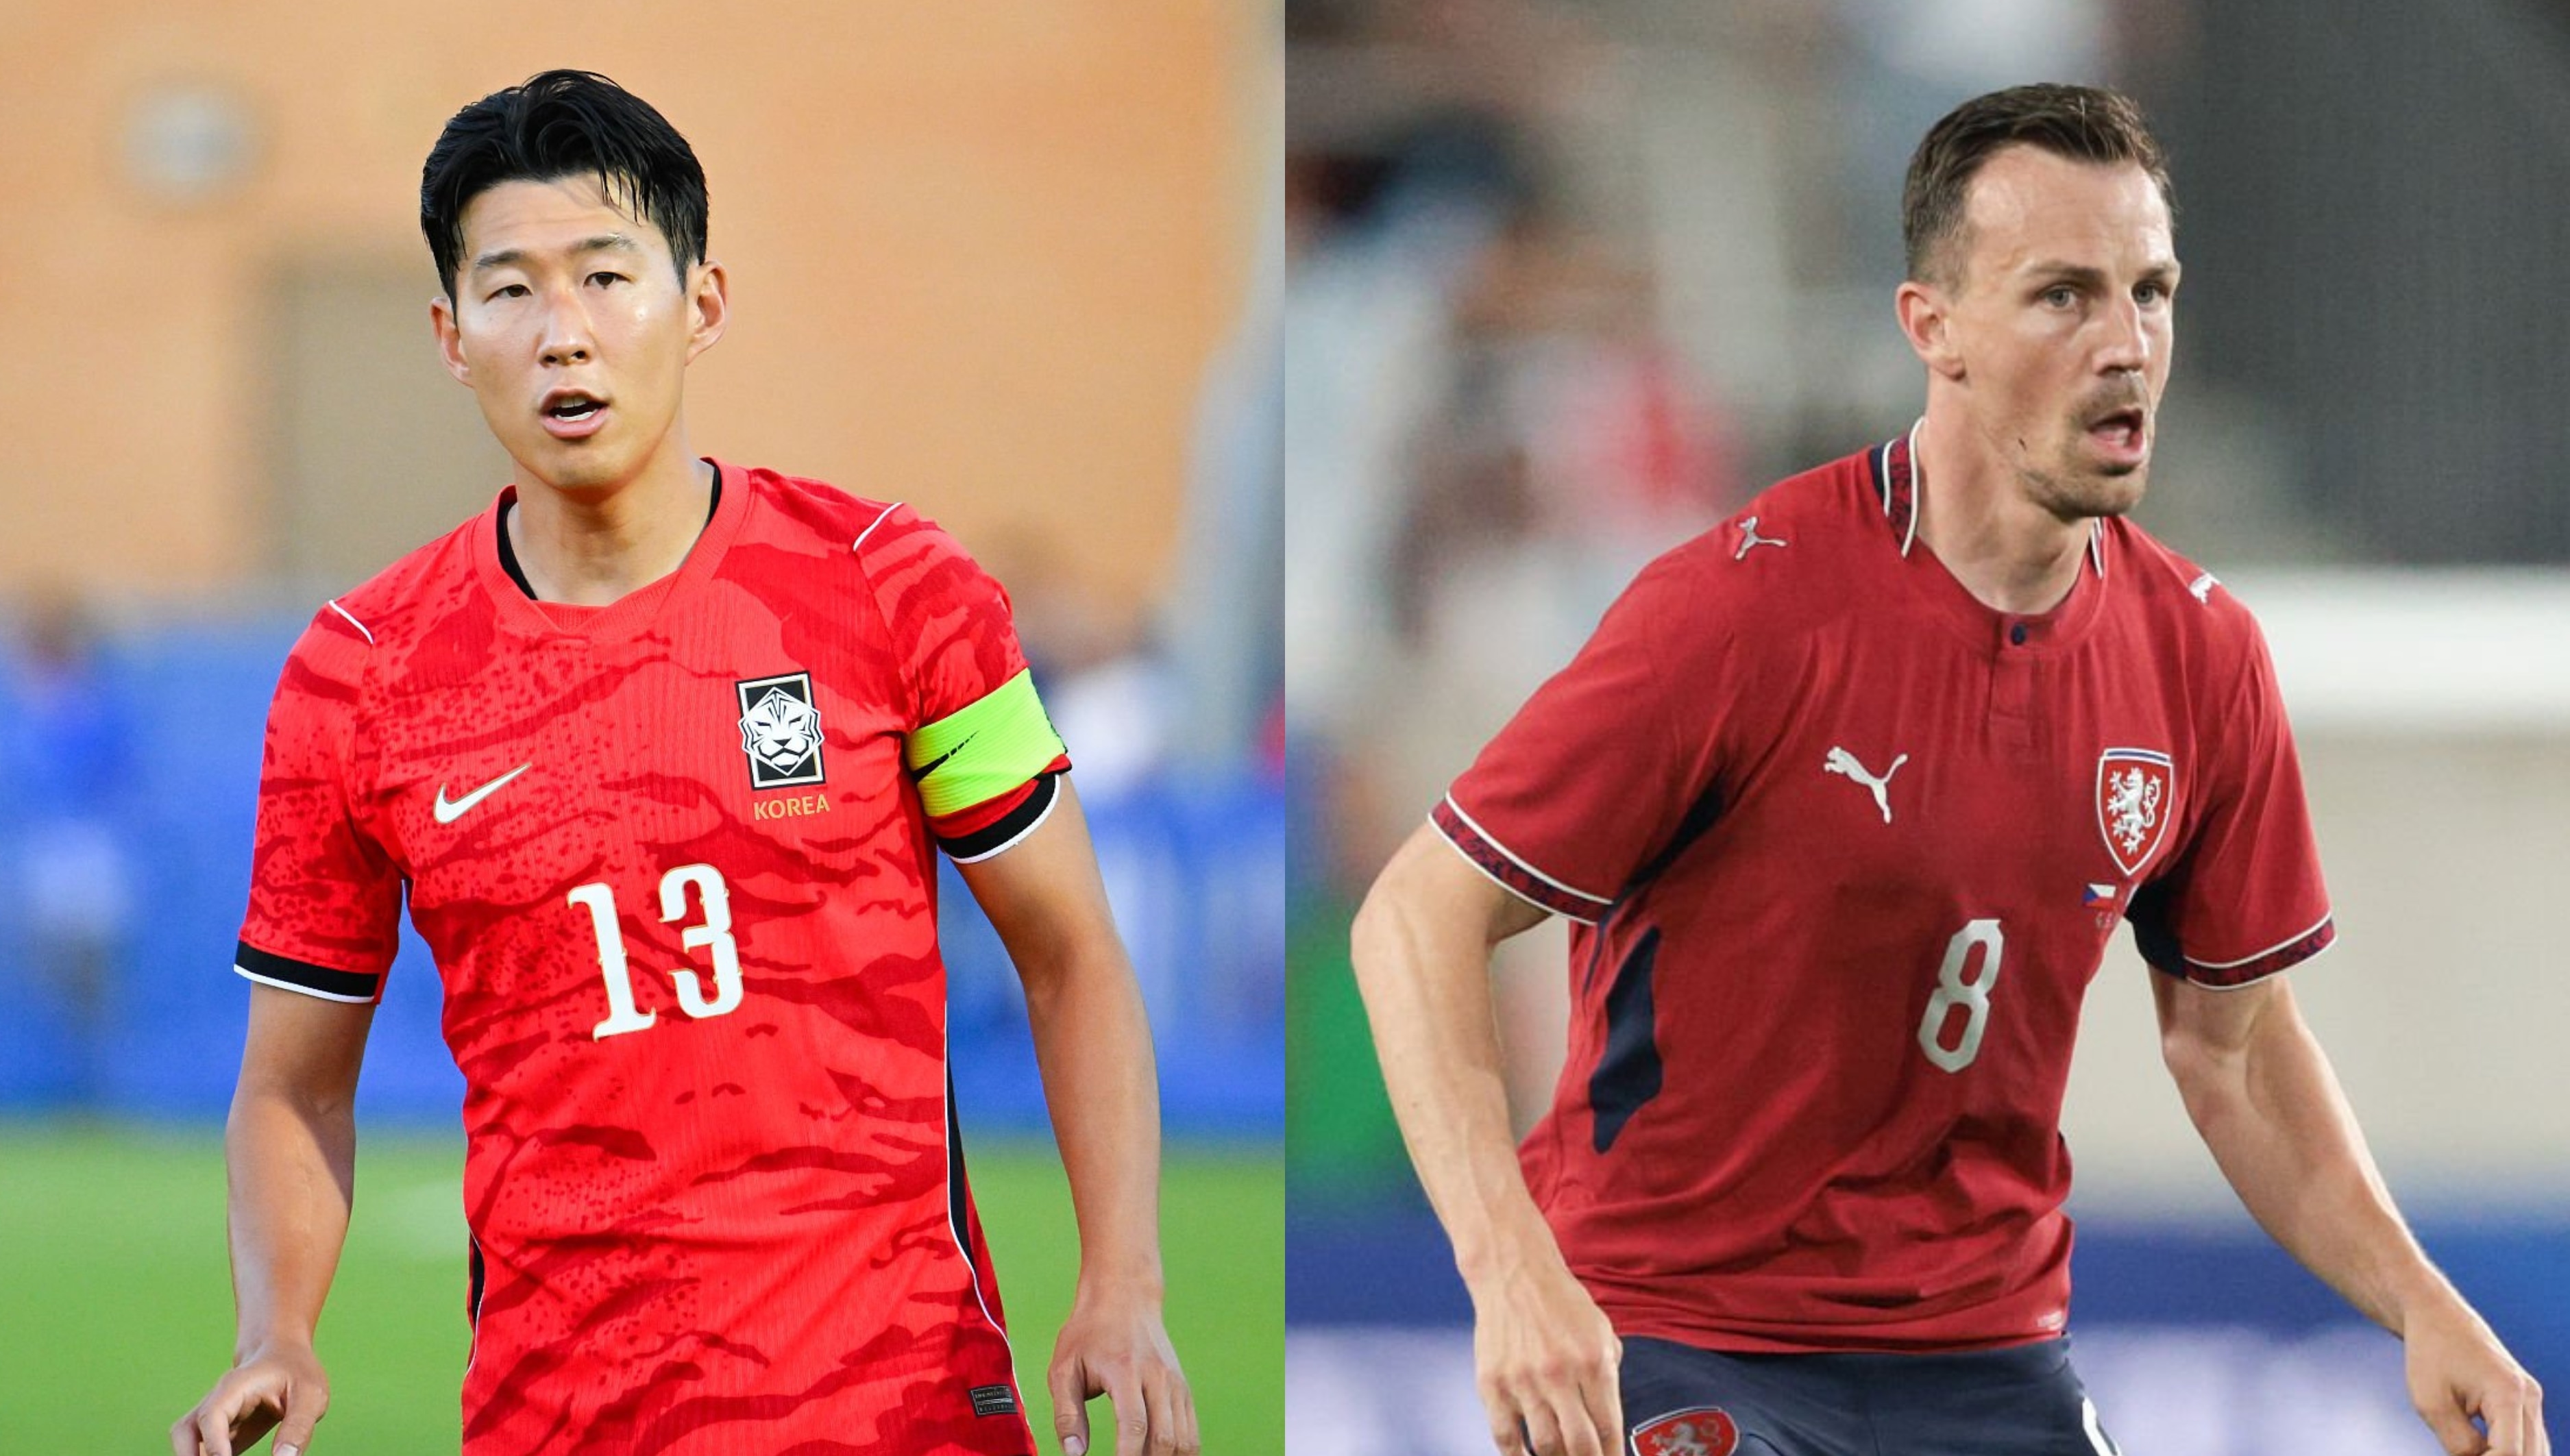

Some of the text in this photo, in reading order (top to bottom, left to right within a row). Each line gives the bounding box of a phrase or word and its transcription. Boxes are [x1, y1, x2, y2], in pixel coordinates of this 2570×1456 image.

[754, 793, 830, 820] KOREA
[567, 863, 744, 1042] 13
[1917, 919, 2004, 1074] 8
